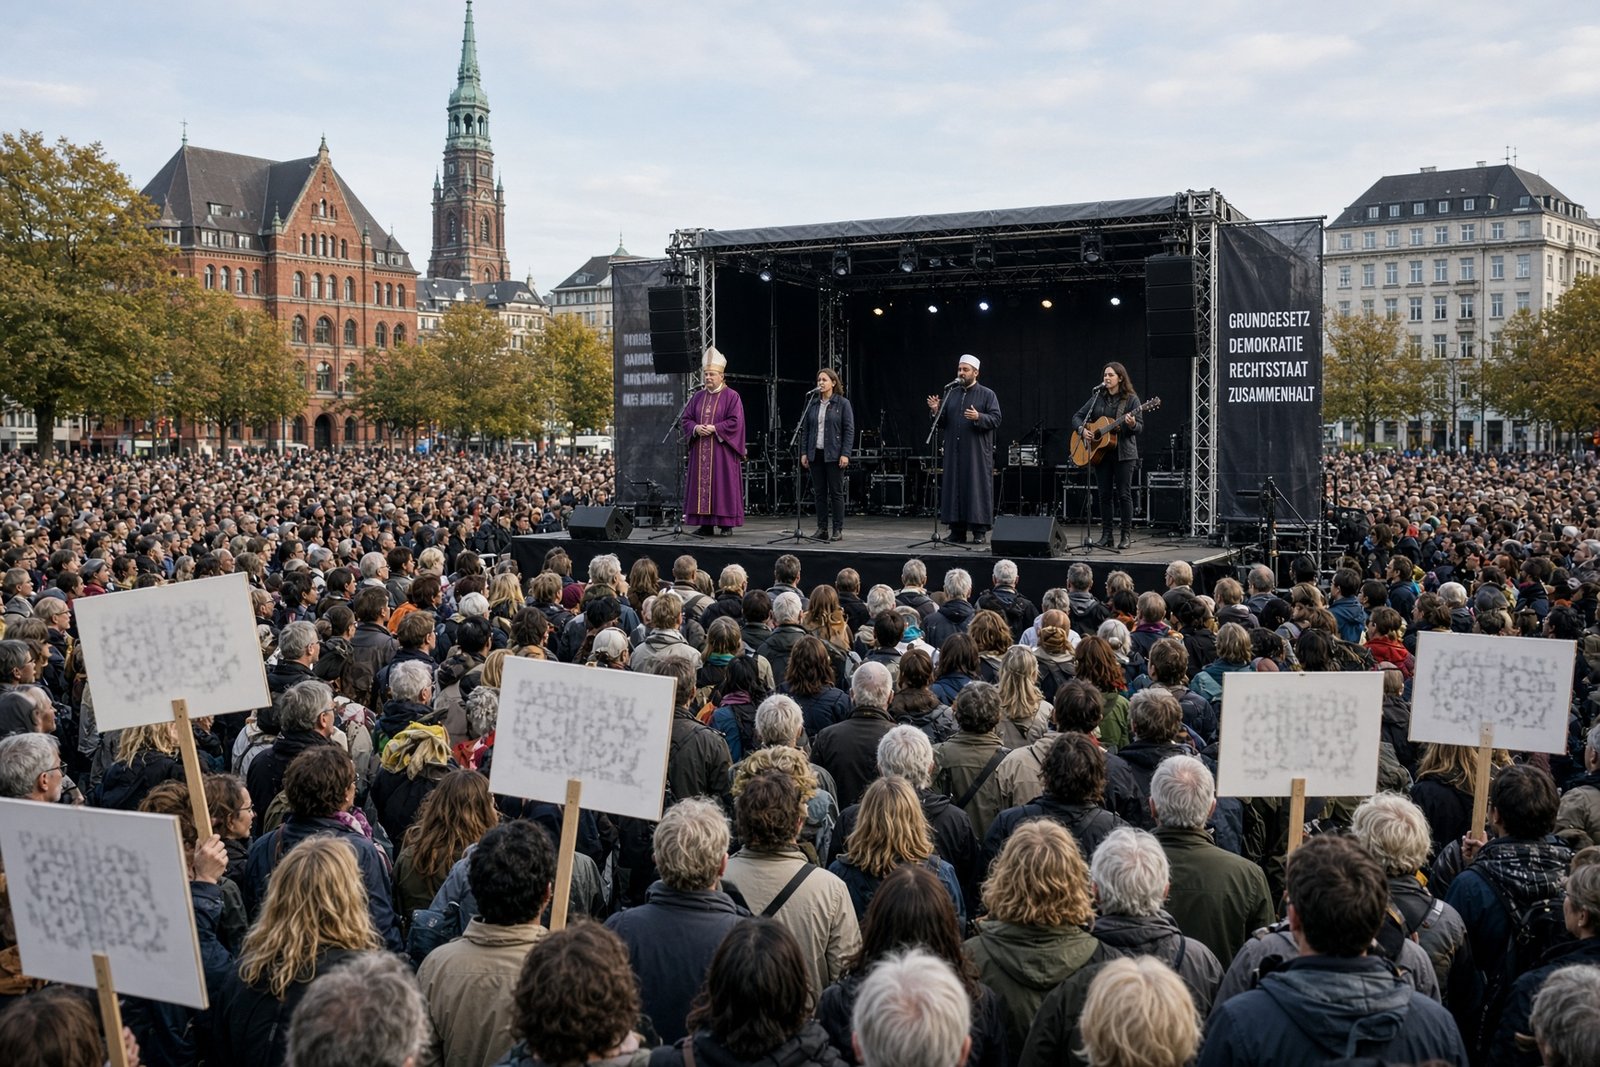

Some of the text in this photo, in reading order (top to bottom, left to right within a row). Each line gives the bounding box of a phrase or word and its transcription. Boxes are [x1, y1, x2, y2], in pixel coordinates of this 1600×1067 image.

[1229, 311, 1310, 328] GRUNDGESETZ
[1229, 336, 1303, 353] DEMOKRATIE
[1229, 361, 1308, 378] RECHTSSTAAT
[1228, 386, 1315, 402] ZUSAMMENHALT
